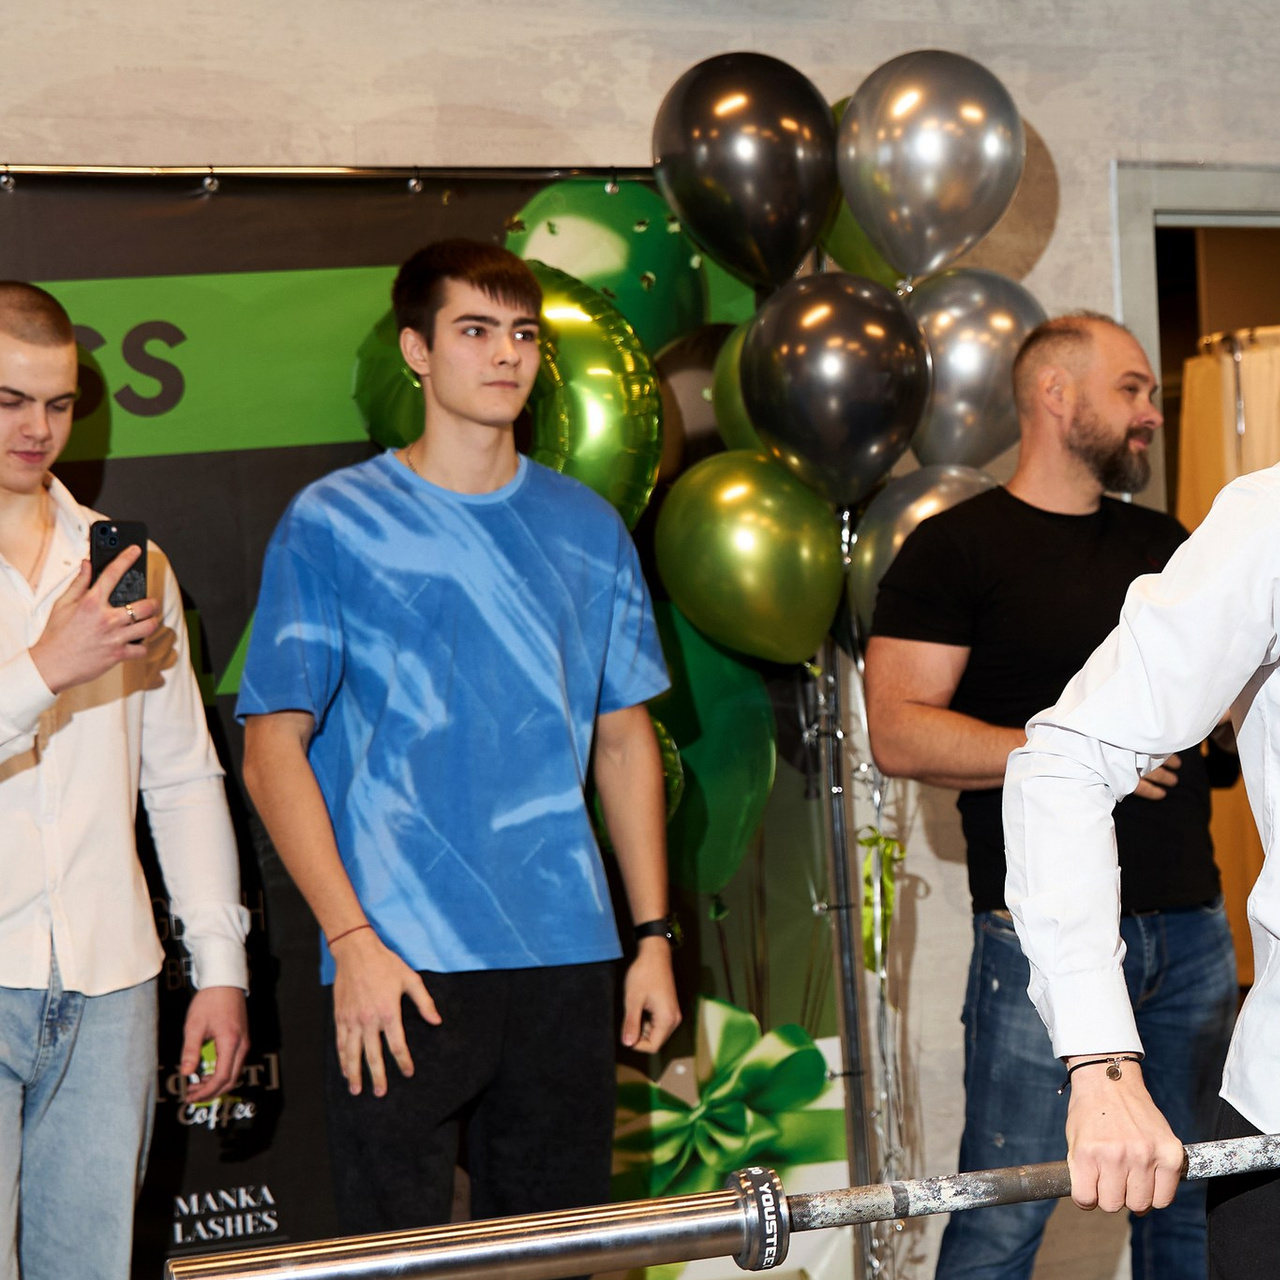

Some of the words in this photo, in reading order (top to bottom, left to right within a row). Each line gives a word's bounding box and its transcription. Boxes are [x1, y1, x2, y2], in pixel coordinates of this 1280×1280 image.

[176, 1095, 259, 1131] Coffee
[173, 1183, 277, 1218] MANKA
[172, 1210, 280, 1245] LASHES
[758, 1182, 778, 1269] YOUSTEE
